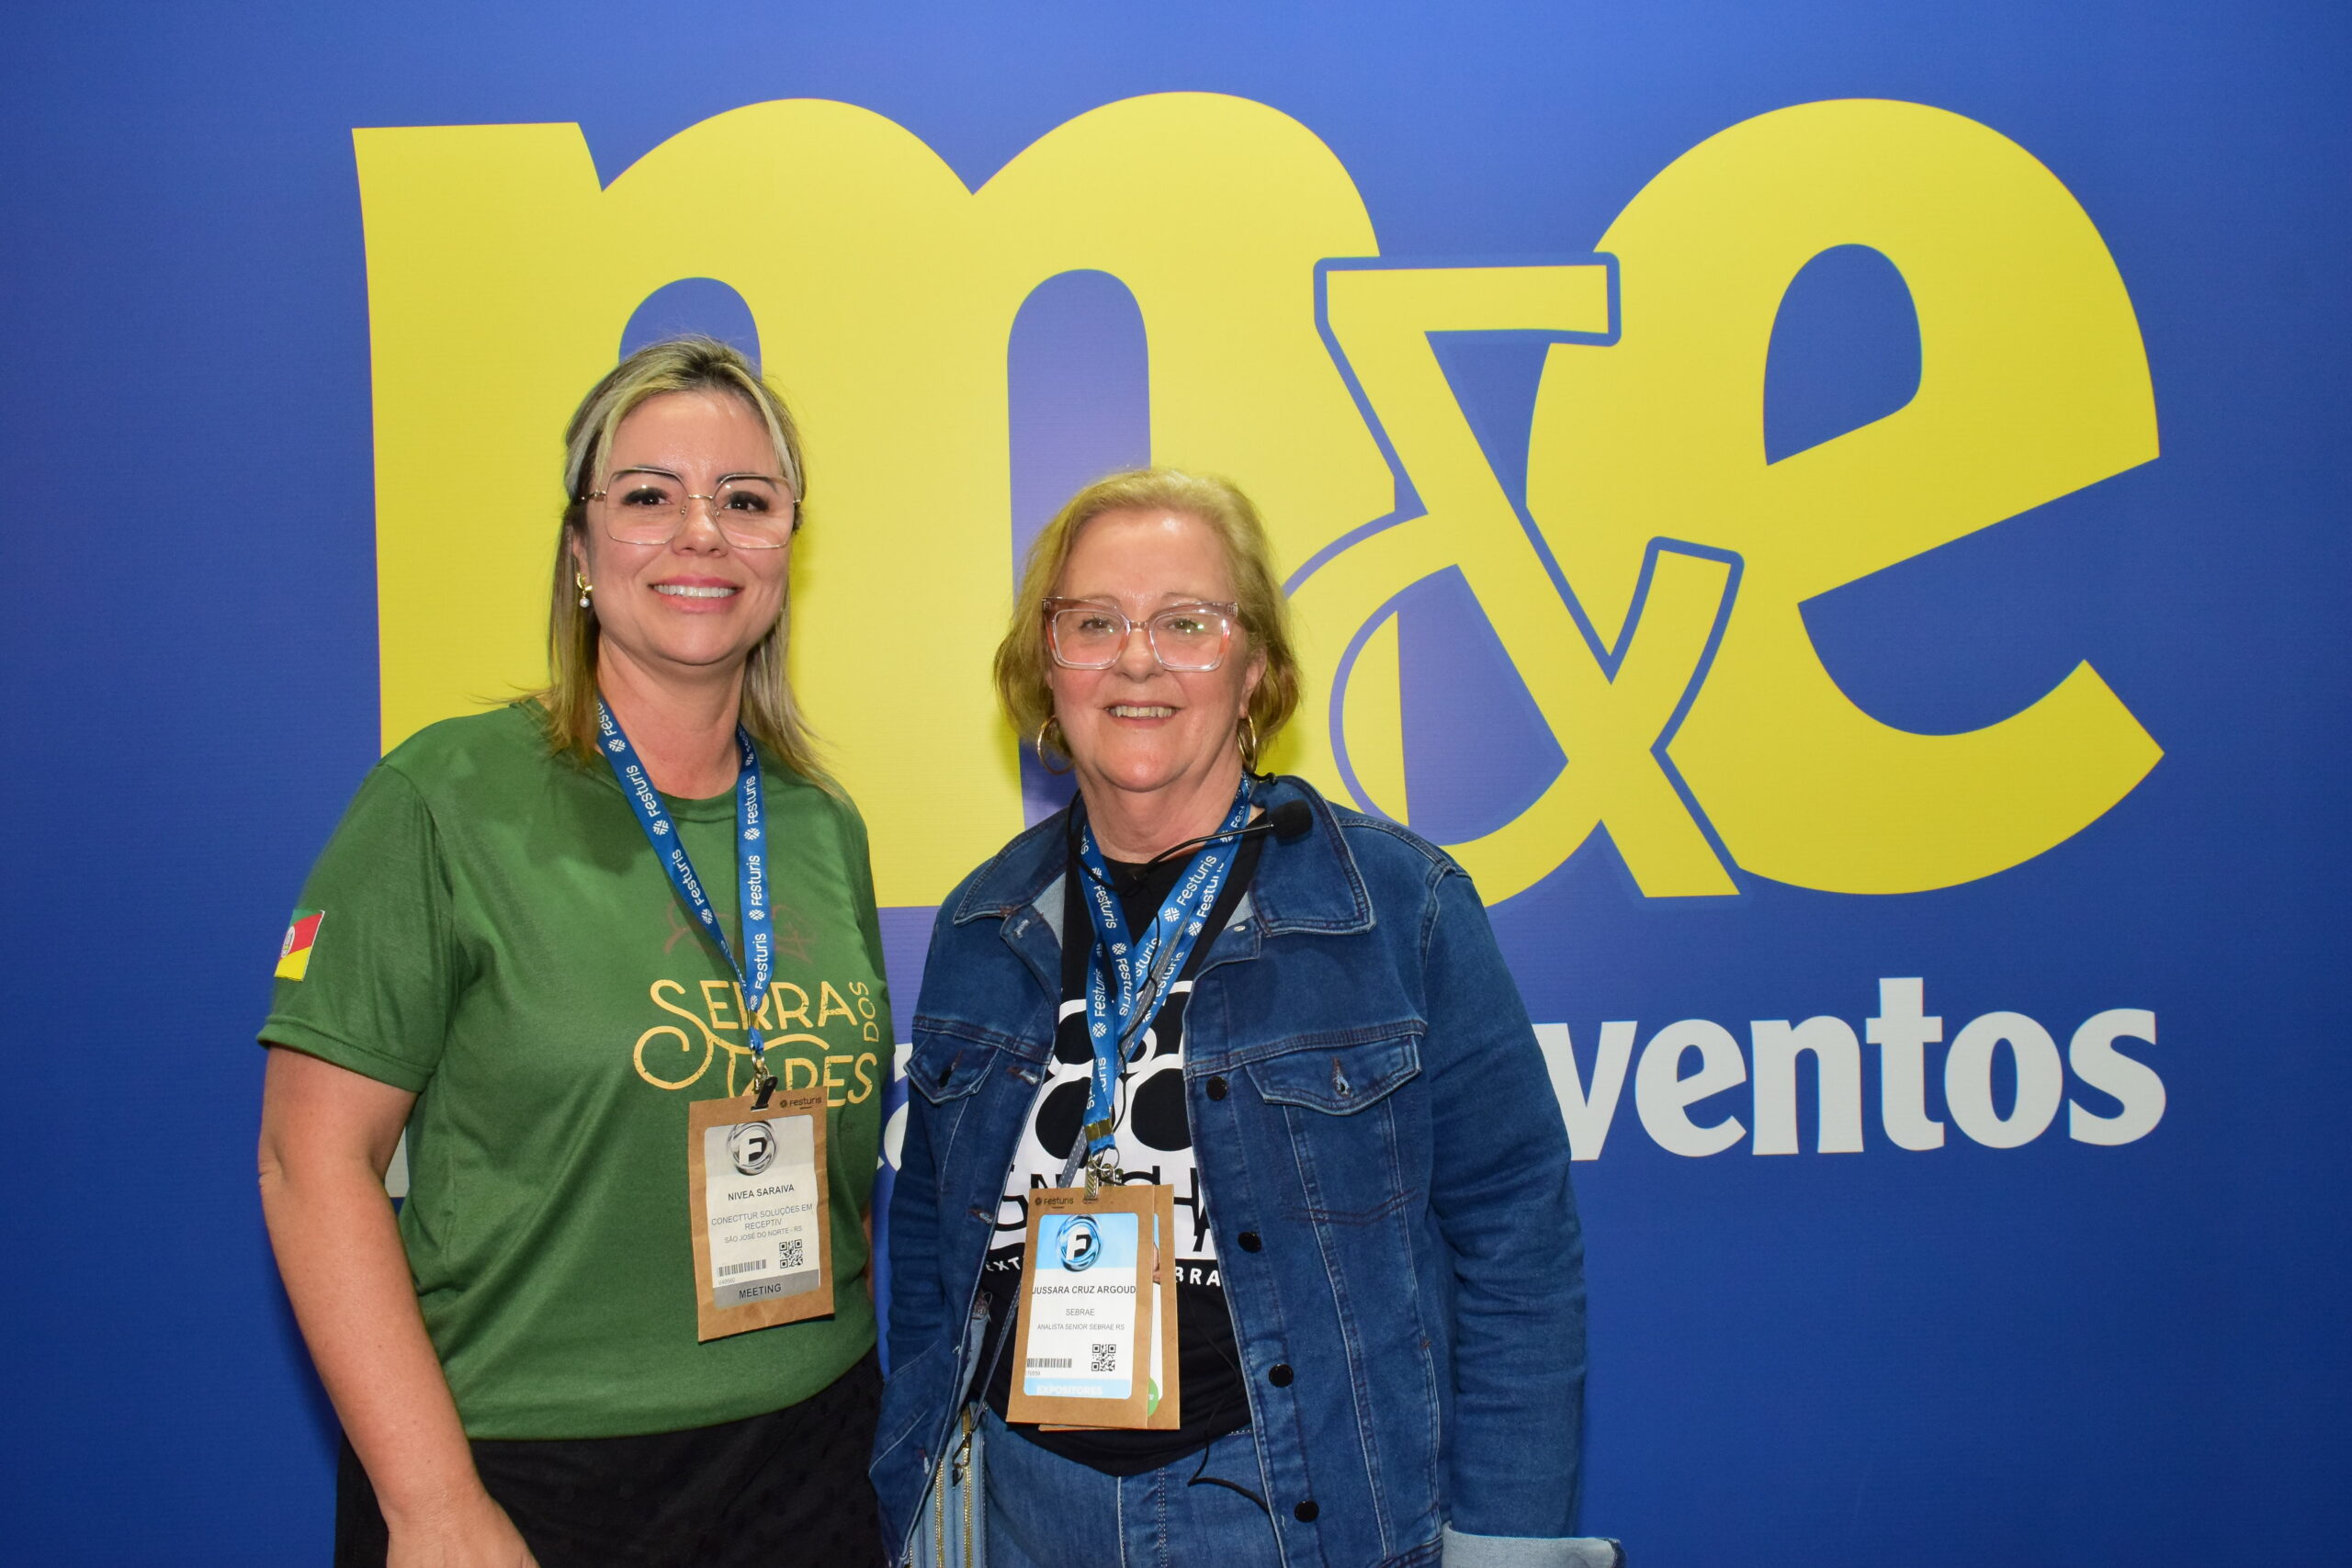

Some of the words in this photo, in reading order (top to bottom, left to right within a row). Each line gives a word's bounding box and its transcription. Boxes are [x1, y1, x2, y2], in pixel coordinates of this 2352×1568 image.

[626, 764, 662, 818] Festuris
[742, 775, 759, 825] Festuris
[672, 848, 705, 906] Festuris
[745, 854, 763, 907] Festuris
[1176, 855, 1217, 907] Festuris
[752, 932, 768, 989] Festuris
[849, 981, 880, 1043] DOS
[1094, 967, 1107, 1017] Festuris
[1115, 957, 1134, 1017] Festuris
[728, 1190, 754, 1201] NIVEA
[756, 1183, 795, 1197] SARAIVA
[801, 1203, 813, 1213] EM
[744, 1218, 783, 1231] RECEPTIV
[756, 1230, 767, 1239] DO
[767, 1227, 790, 1237] NORTE
[739, 1283, 782, 1300] MEETING
[1032, 1286, 1069, 1295] JUSSARA
[1071, 1285, 1095, 1294] CRUZ
[1096, 1285, 1136, 1294] ARGOUD
[1066, 1308, 1095, 1316] SEBRAE
